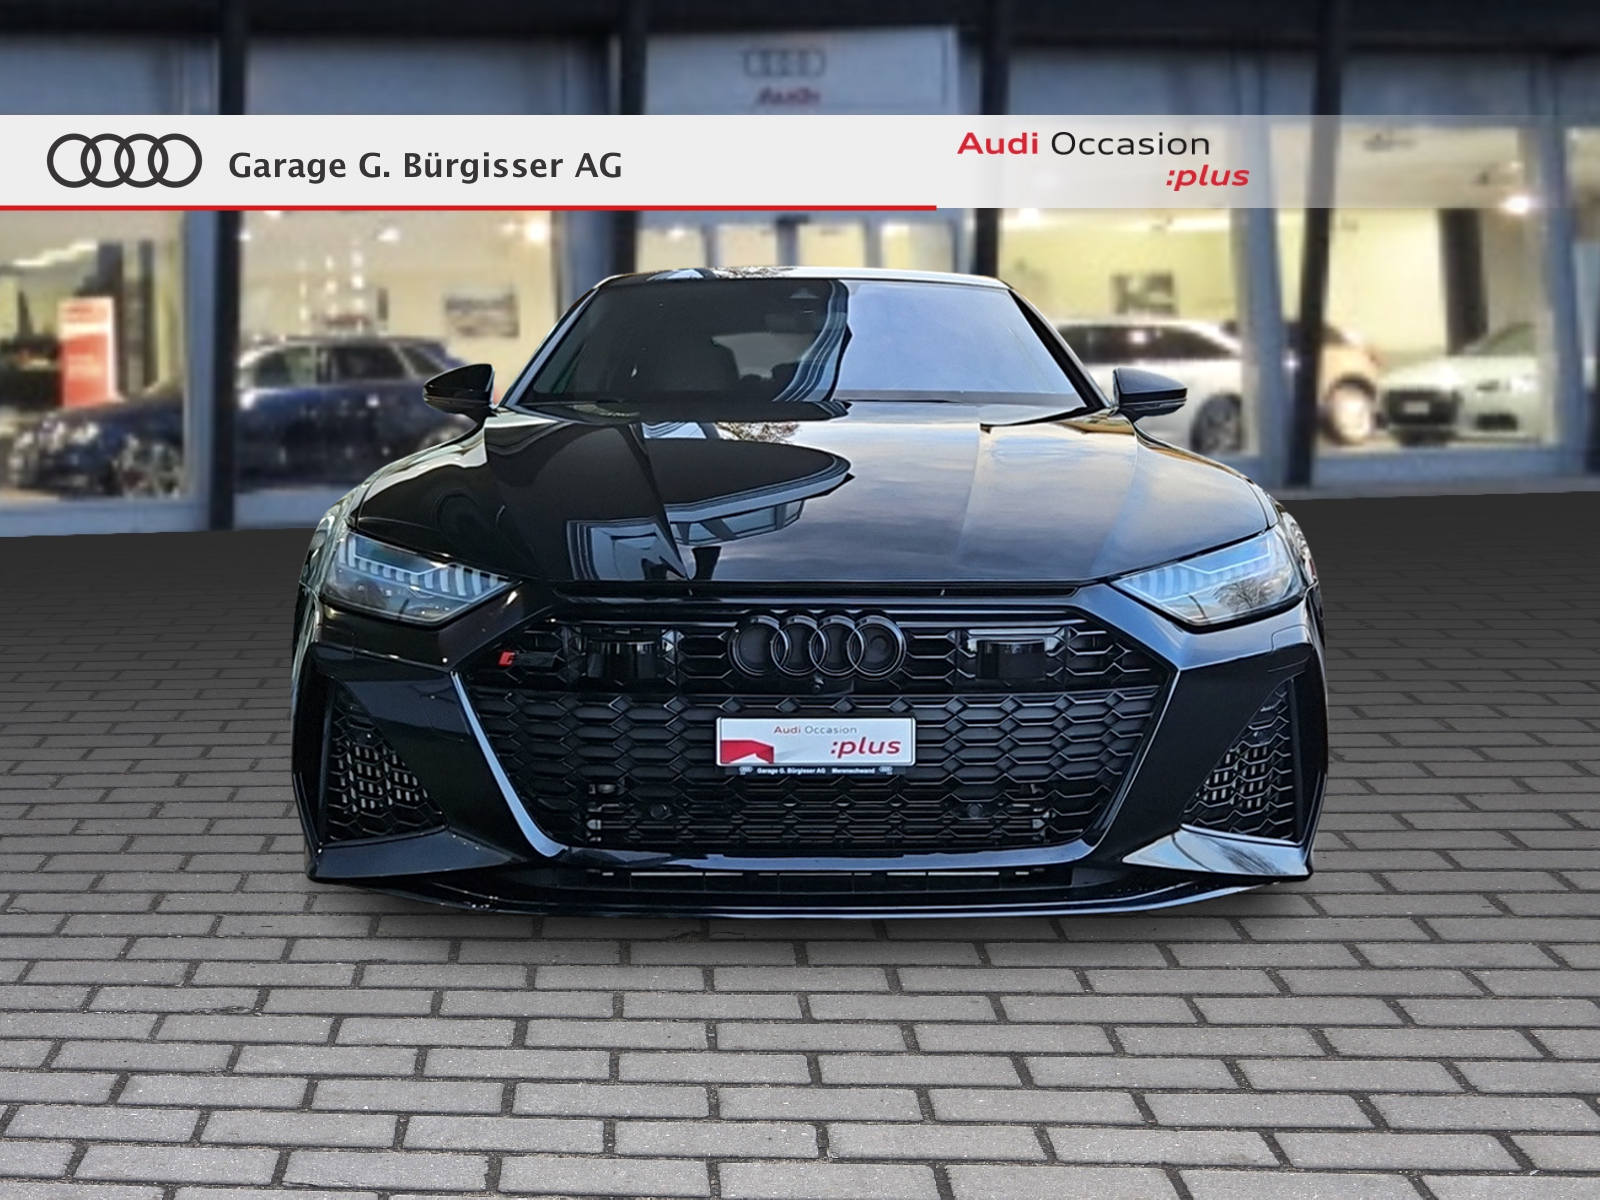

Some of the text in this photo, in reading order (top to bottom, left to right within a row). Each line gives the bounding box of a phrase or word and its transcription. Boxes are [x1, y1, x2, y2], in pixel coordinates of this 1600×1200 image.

[773, 725, 857, 735] Audi Occasion
[830, 737, 901, 759] :plus
[757, 767, 778, 775] Garage
